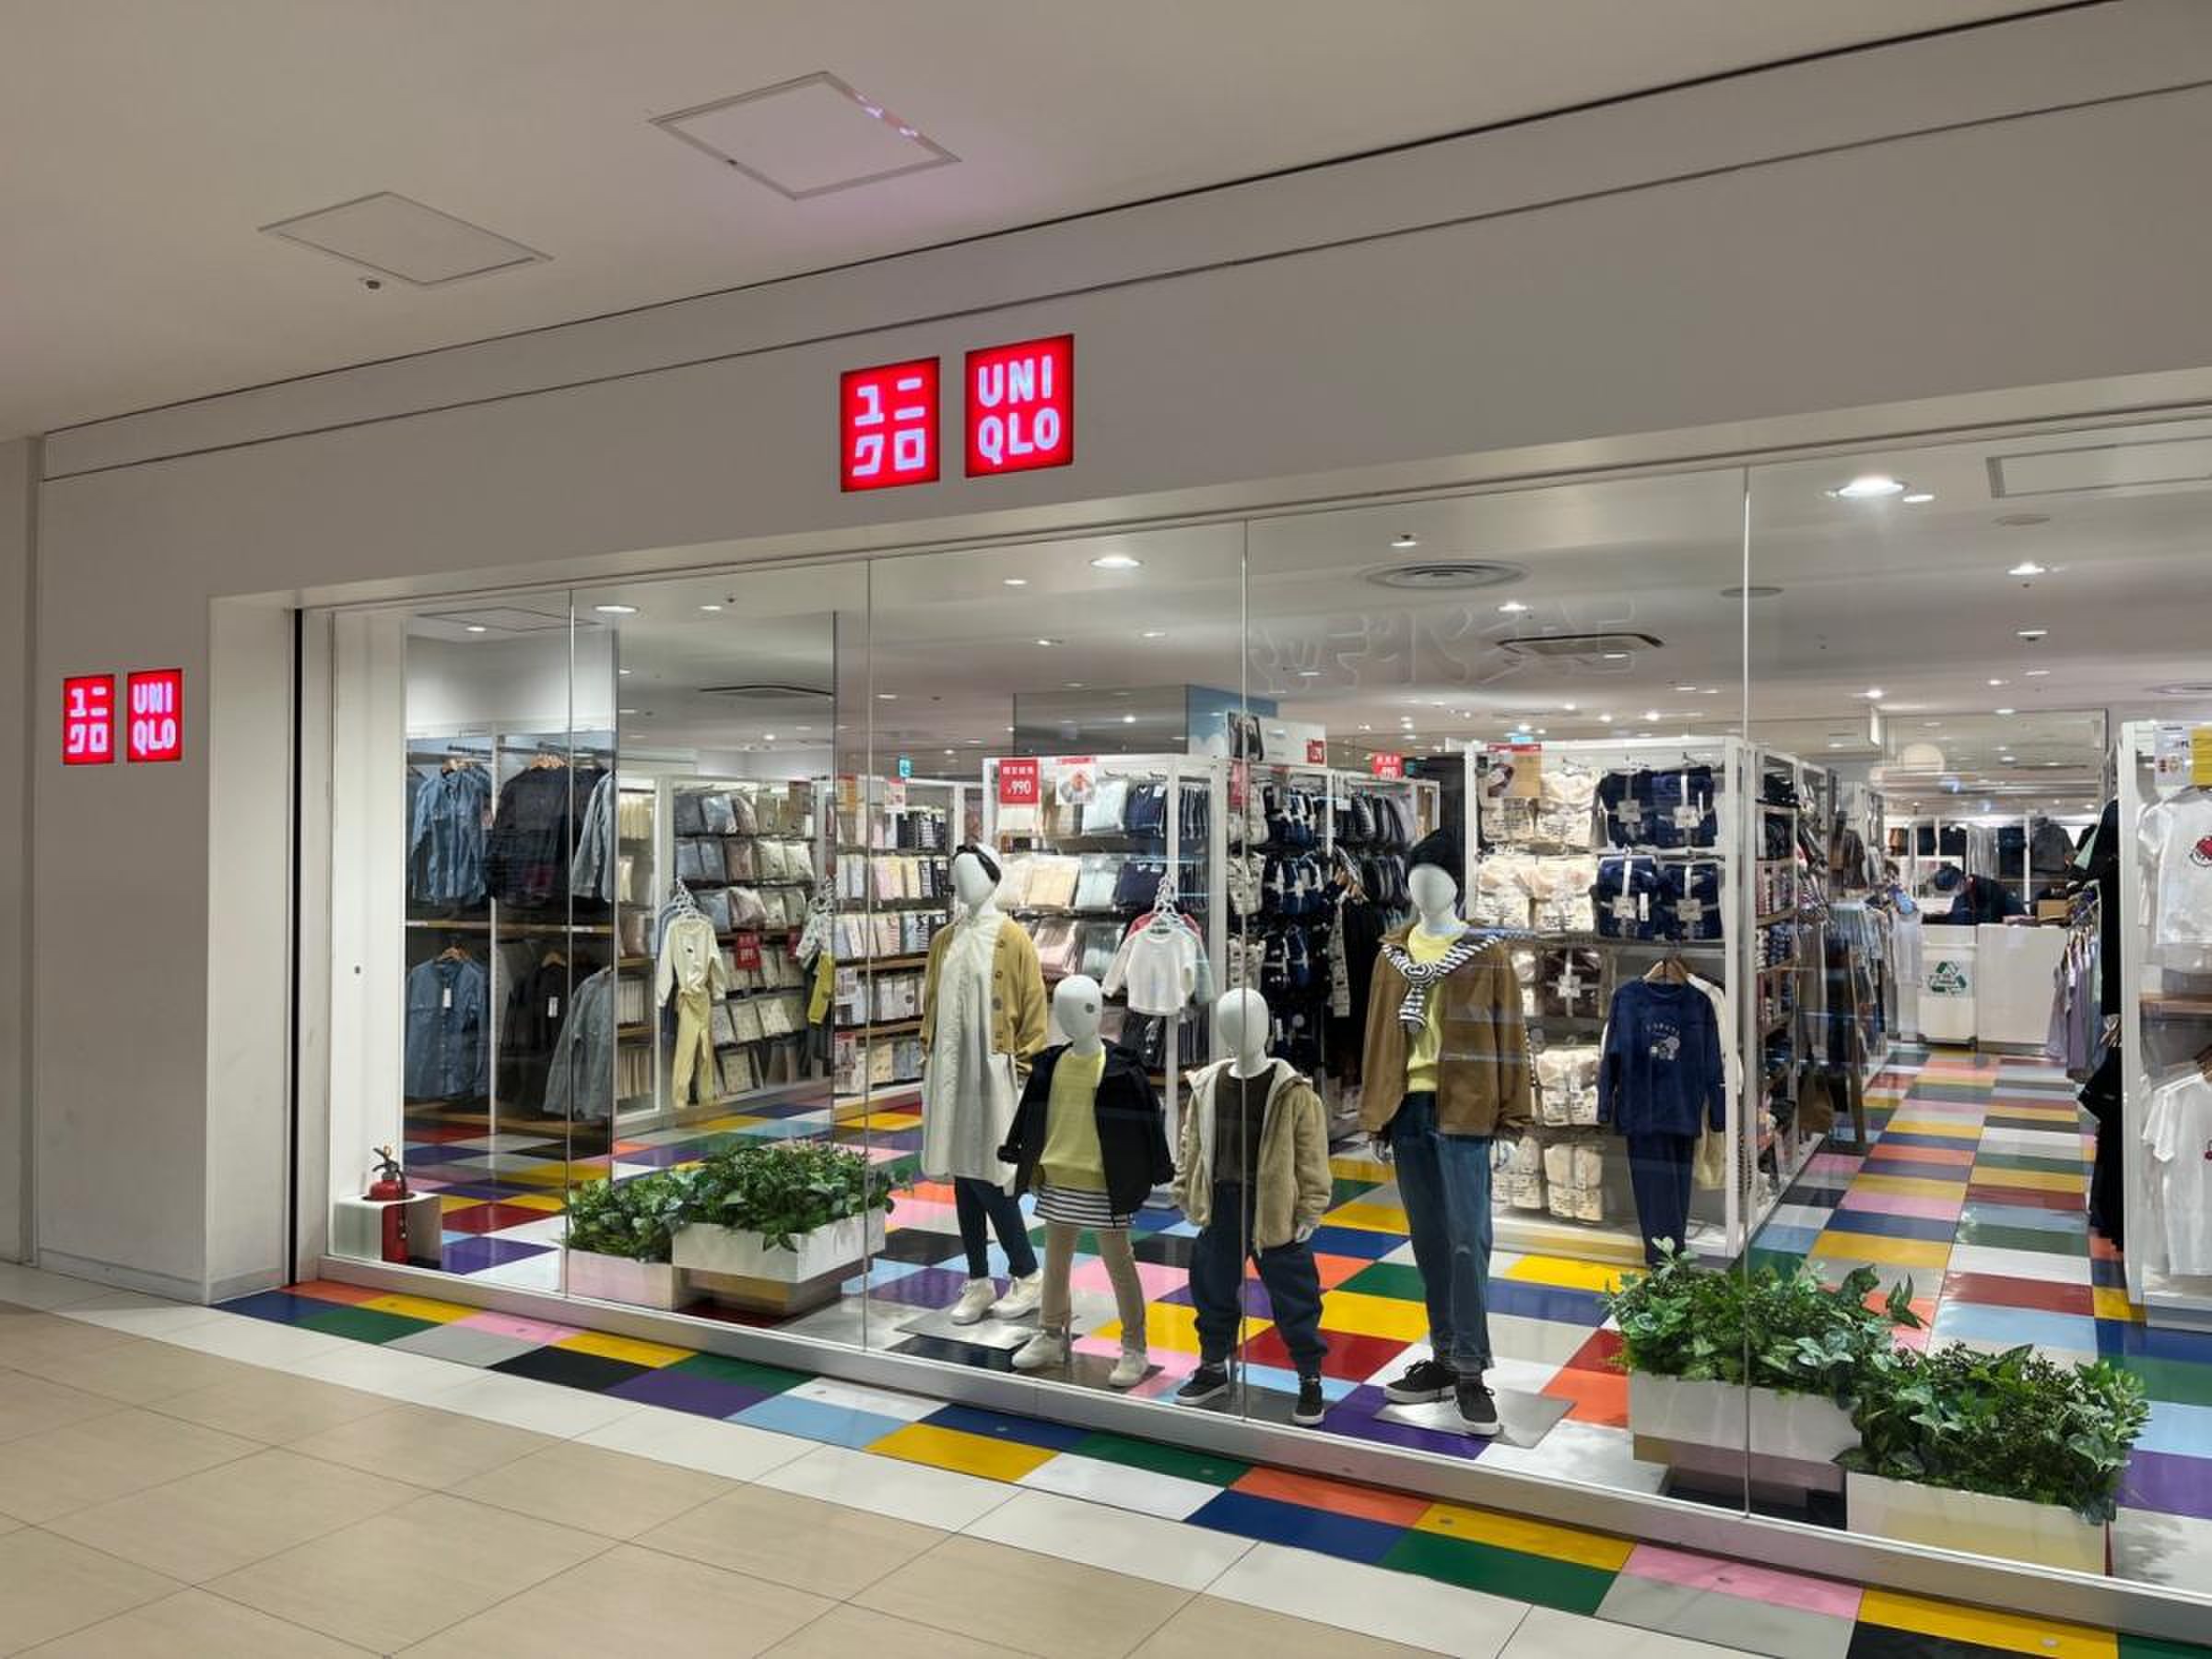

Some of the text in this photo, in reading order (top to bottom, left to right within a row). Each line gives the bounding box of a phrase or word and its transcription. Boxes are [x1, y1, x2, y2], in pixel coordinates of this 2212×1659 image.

[854, 377, 925, 427] ユニ
[978, 355, 1053, 407] UNI
[853, 427, 925, 477] クロ
[978, 407, 1060, 465] QLO
[69, 686, 108, 718] ユニ
[133, 681, 173, 714] UNI
[67, 722, 108, 753] クロ
[133, 717, 176, 756] QLO
